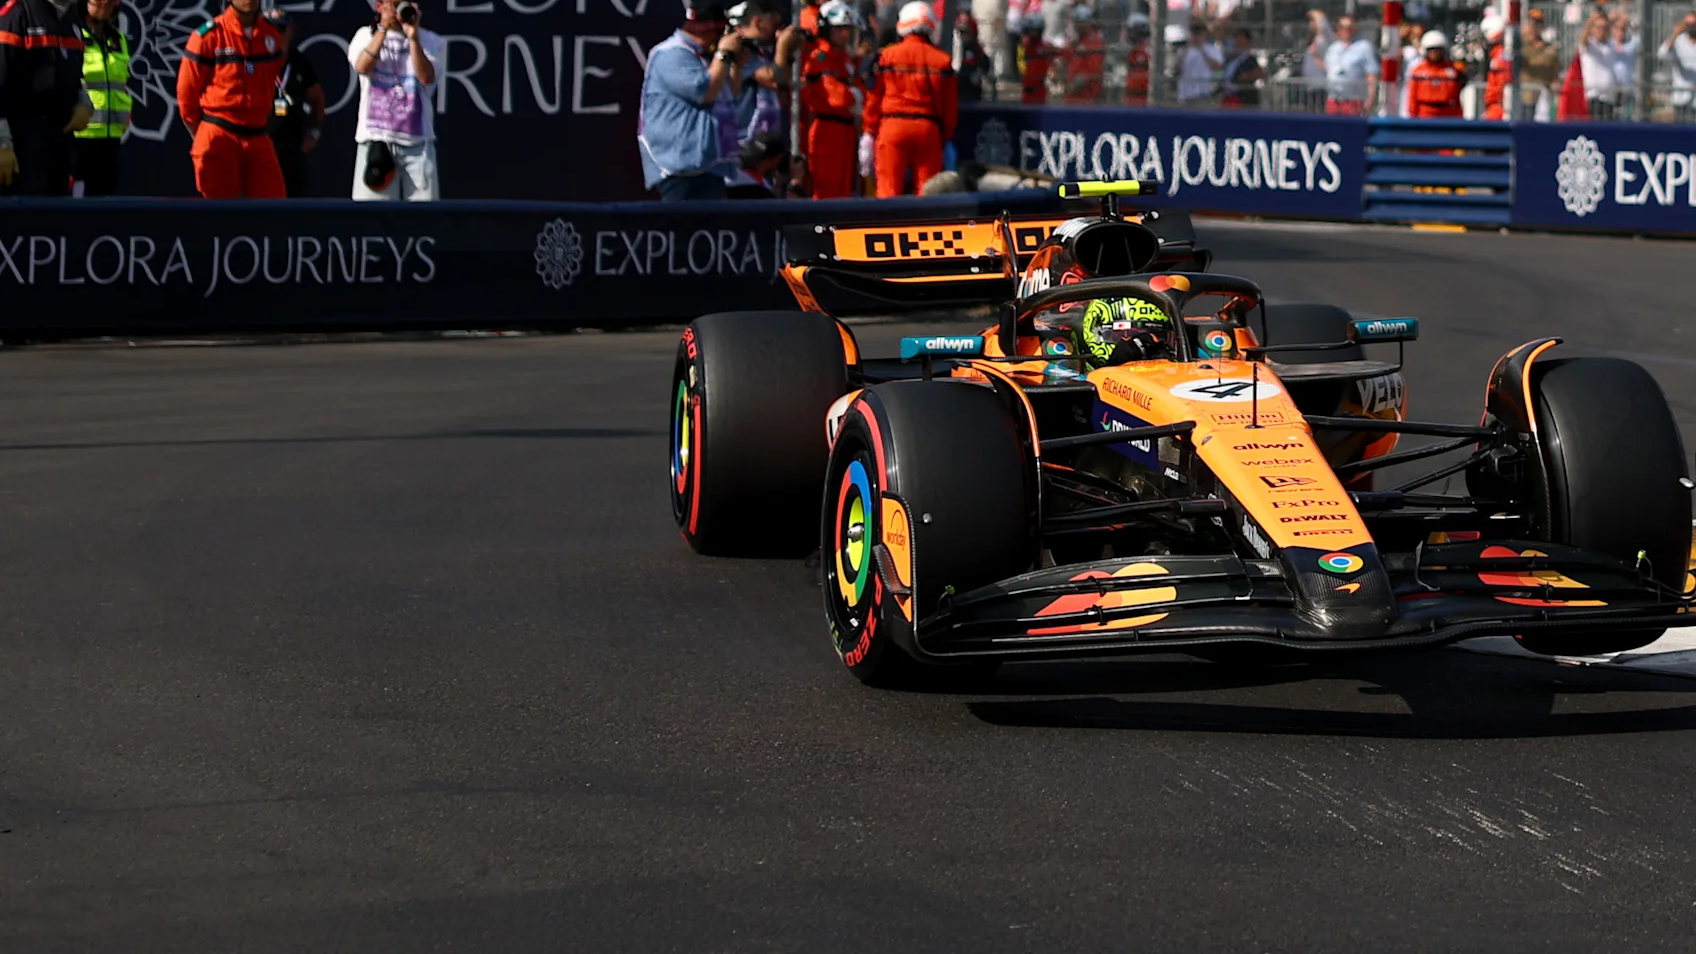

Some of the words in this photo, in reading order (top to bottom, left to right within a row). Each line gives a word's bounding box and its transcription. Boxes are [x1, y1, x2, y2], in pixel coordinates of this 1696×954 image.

[1020, 130, 1164, 184] EXPLORA
[1168, 135, 1342, 196] JOURNEYS
[595, 230, 763, 276] EXPLORA
[864, 230, 963, 258] OKX
[0, 236, 193, 286] XPLORA
[204, 236, 436, 298] JOURNEYS
[1367, 321, 1407, 335] allwyn
[925, 337, 974, 352] allwyn
[1102, 377, 1132, 401] RICHARD
[1133, 390, 1153, 411] MILLE
[1189, 381, 1255, 398] 4
[1241, 458, 1315, 466] webex
[1271, 499, 1340, 508] FxPro
[886, 530, 906, 551] workday
